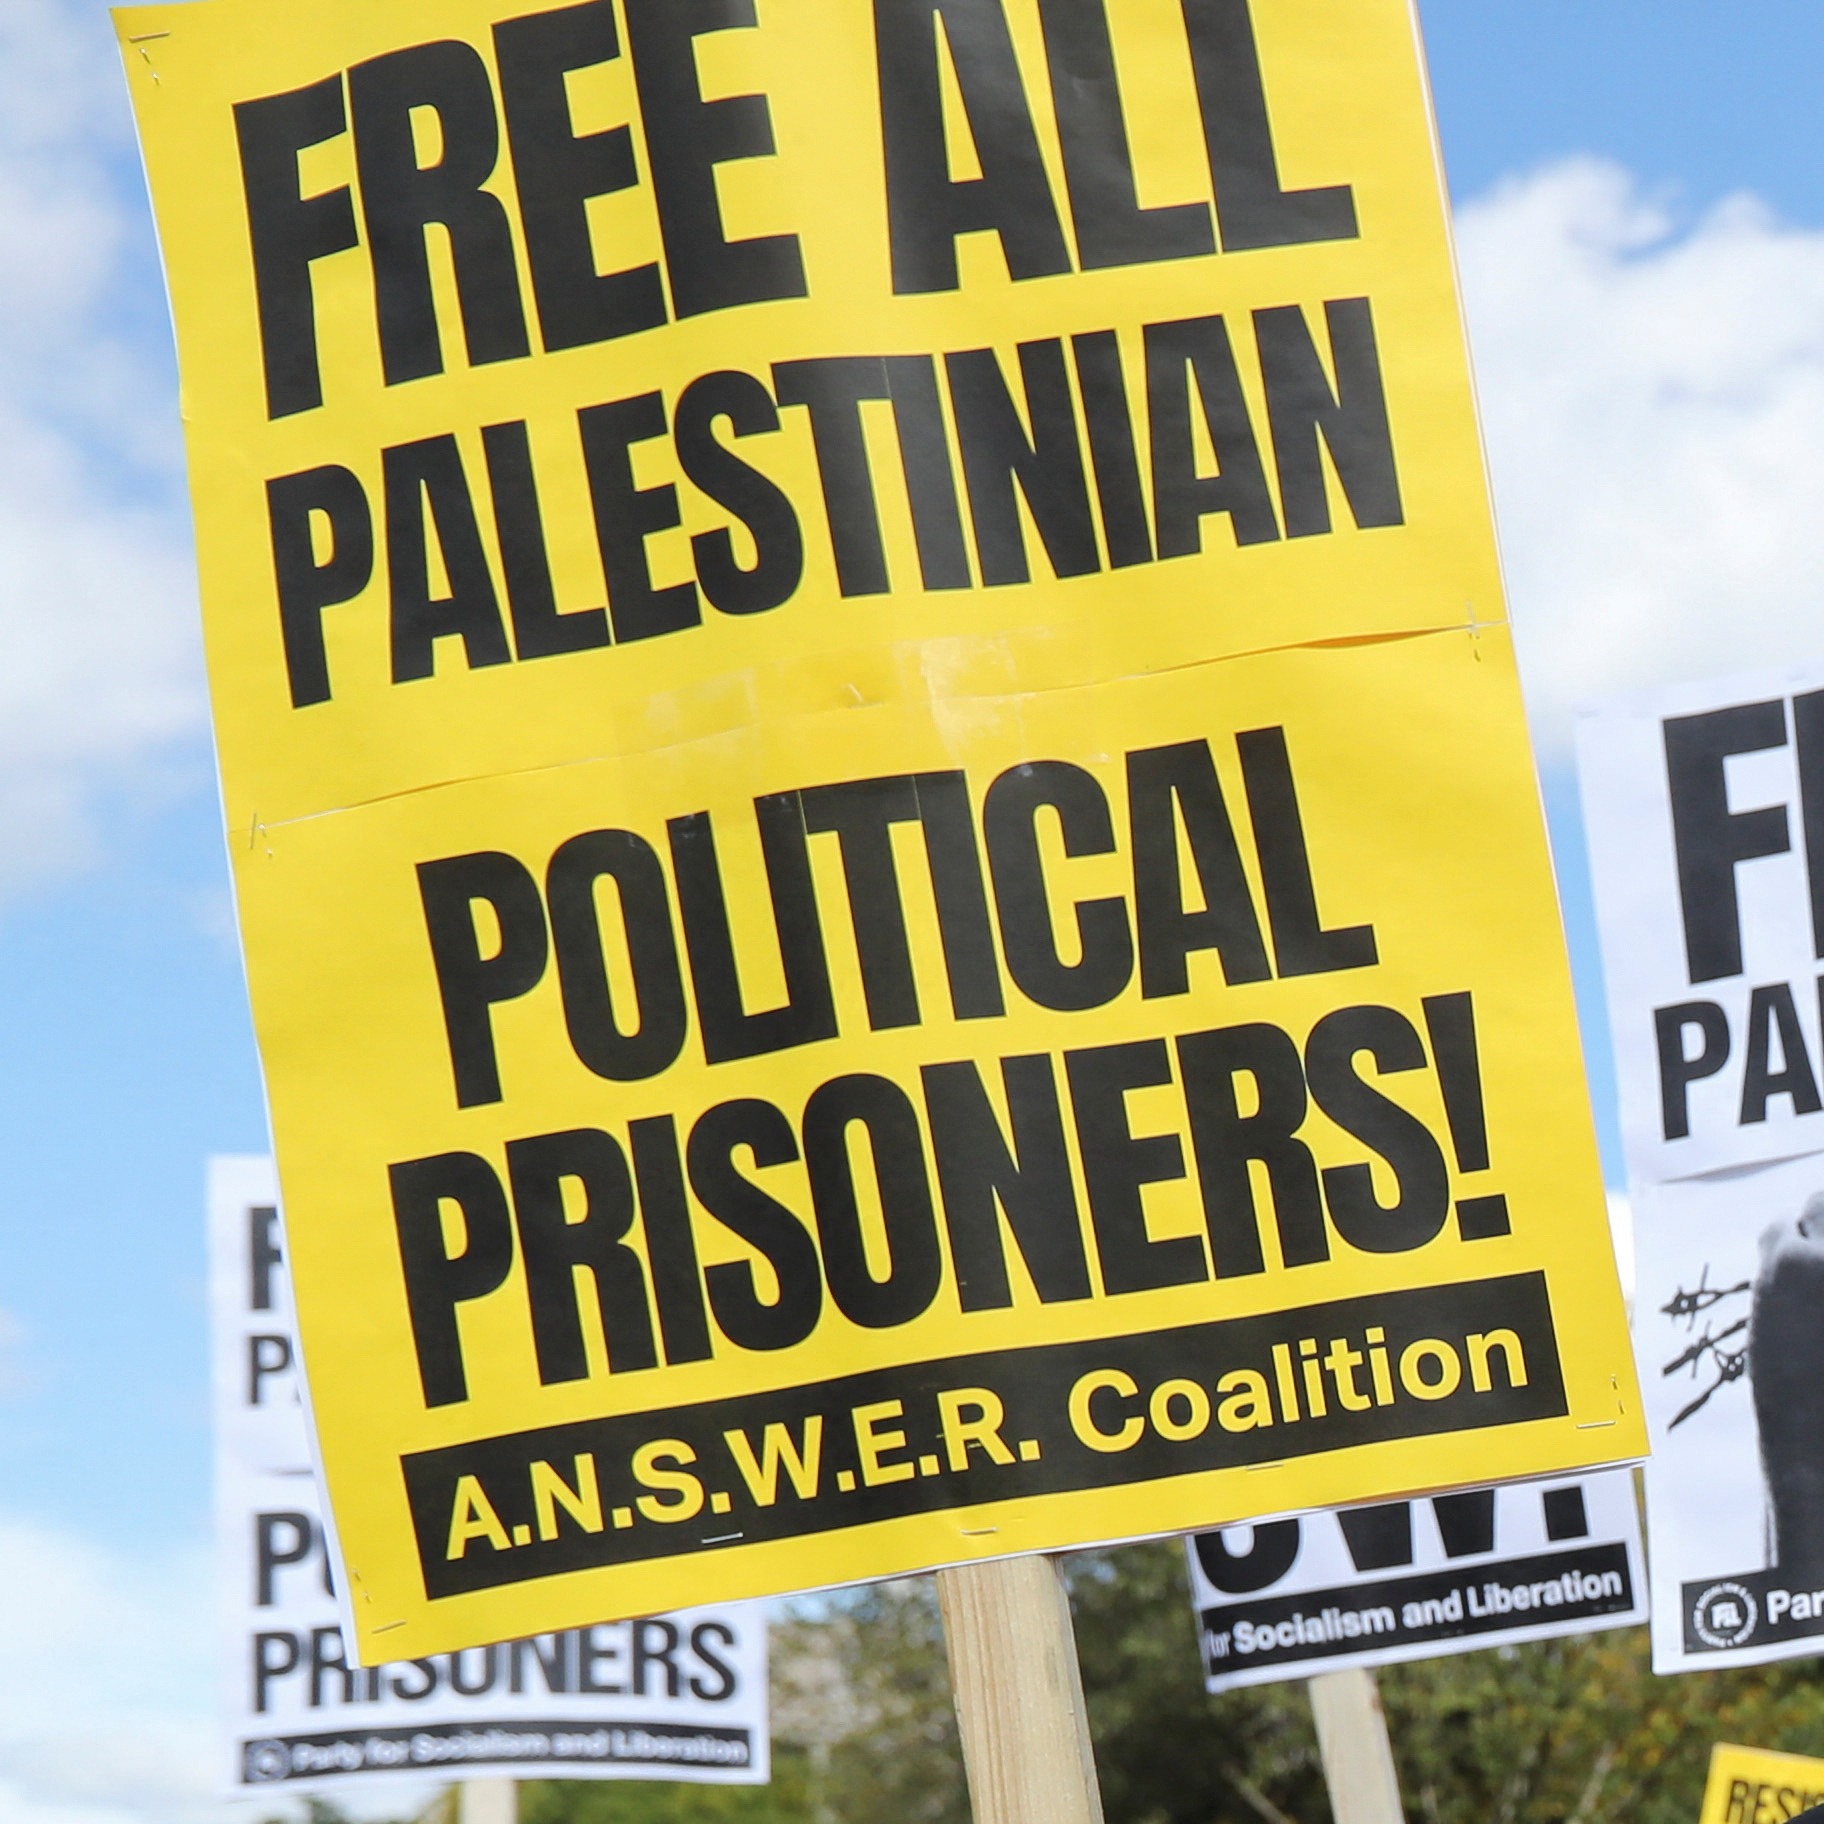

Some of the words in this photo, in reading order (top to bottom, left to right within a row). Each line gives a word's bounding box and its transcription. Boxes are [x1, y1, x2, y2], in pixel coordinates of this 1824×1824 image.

[232, 0, 808, 421] FREE
[873, 0, 1361, 296] ALL
[264, 296, 1405, 711] PALESTINIAN
[415, 725, 1375, 1110] POLITICAL
[389, 992, 1511, 1410] PRISONERS!
[446, 1385, 1038, 1561] A.N.S.W.E.R.
[1070, 1327, 1527, 1455] Coalition
[1232, 1600, 1396, 1655] Socialism
[1402, 1588, 1463, 1629] and
[1466, 1568, 1623, 1619] Liberation
